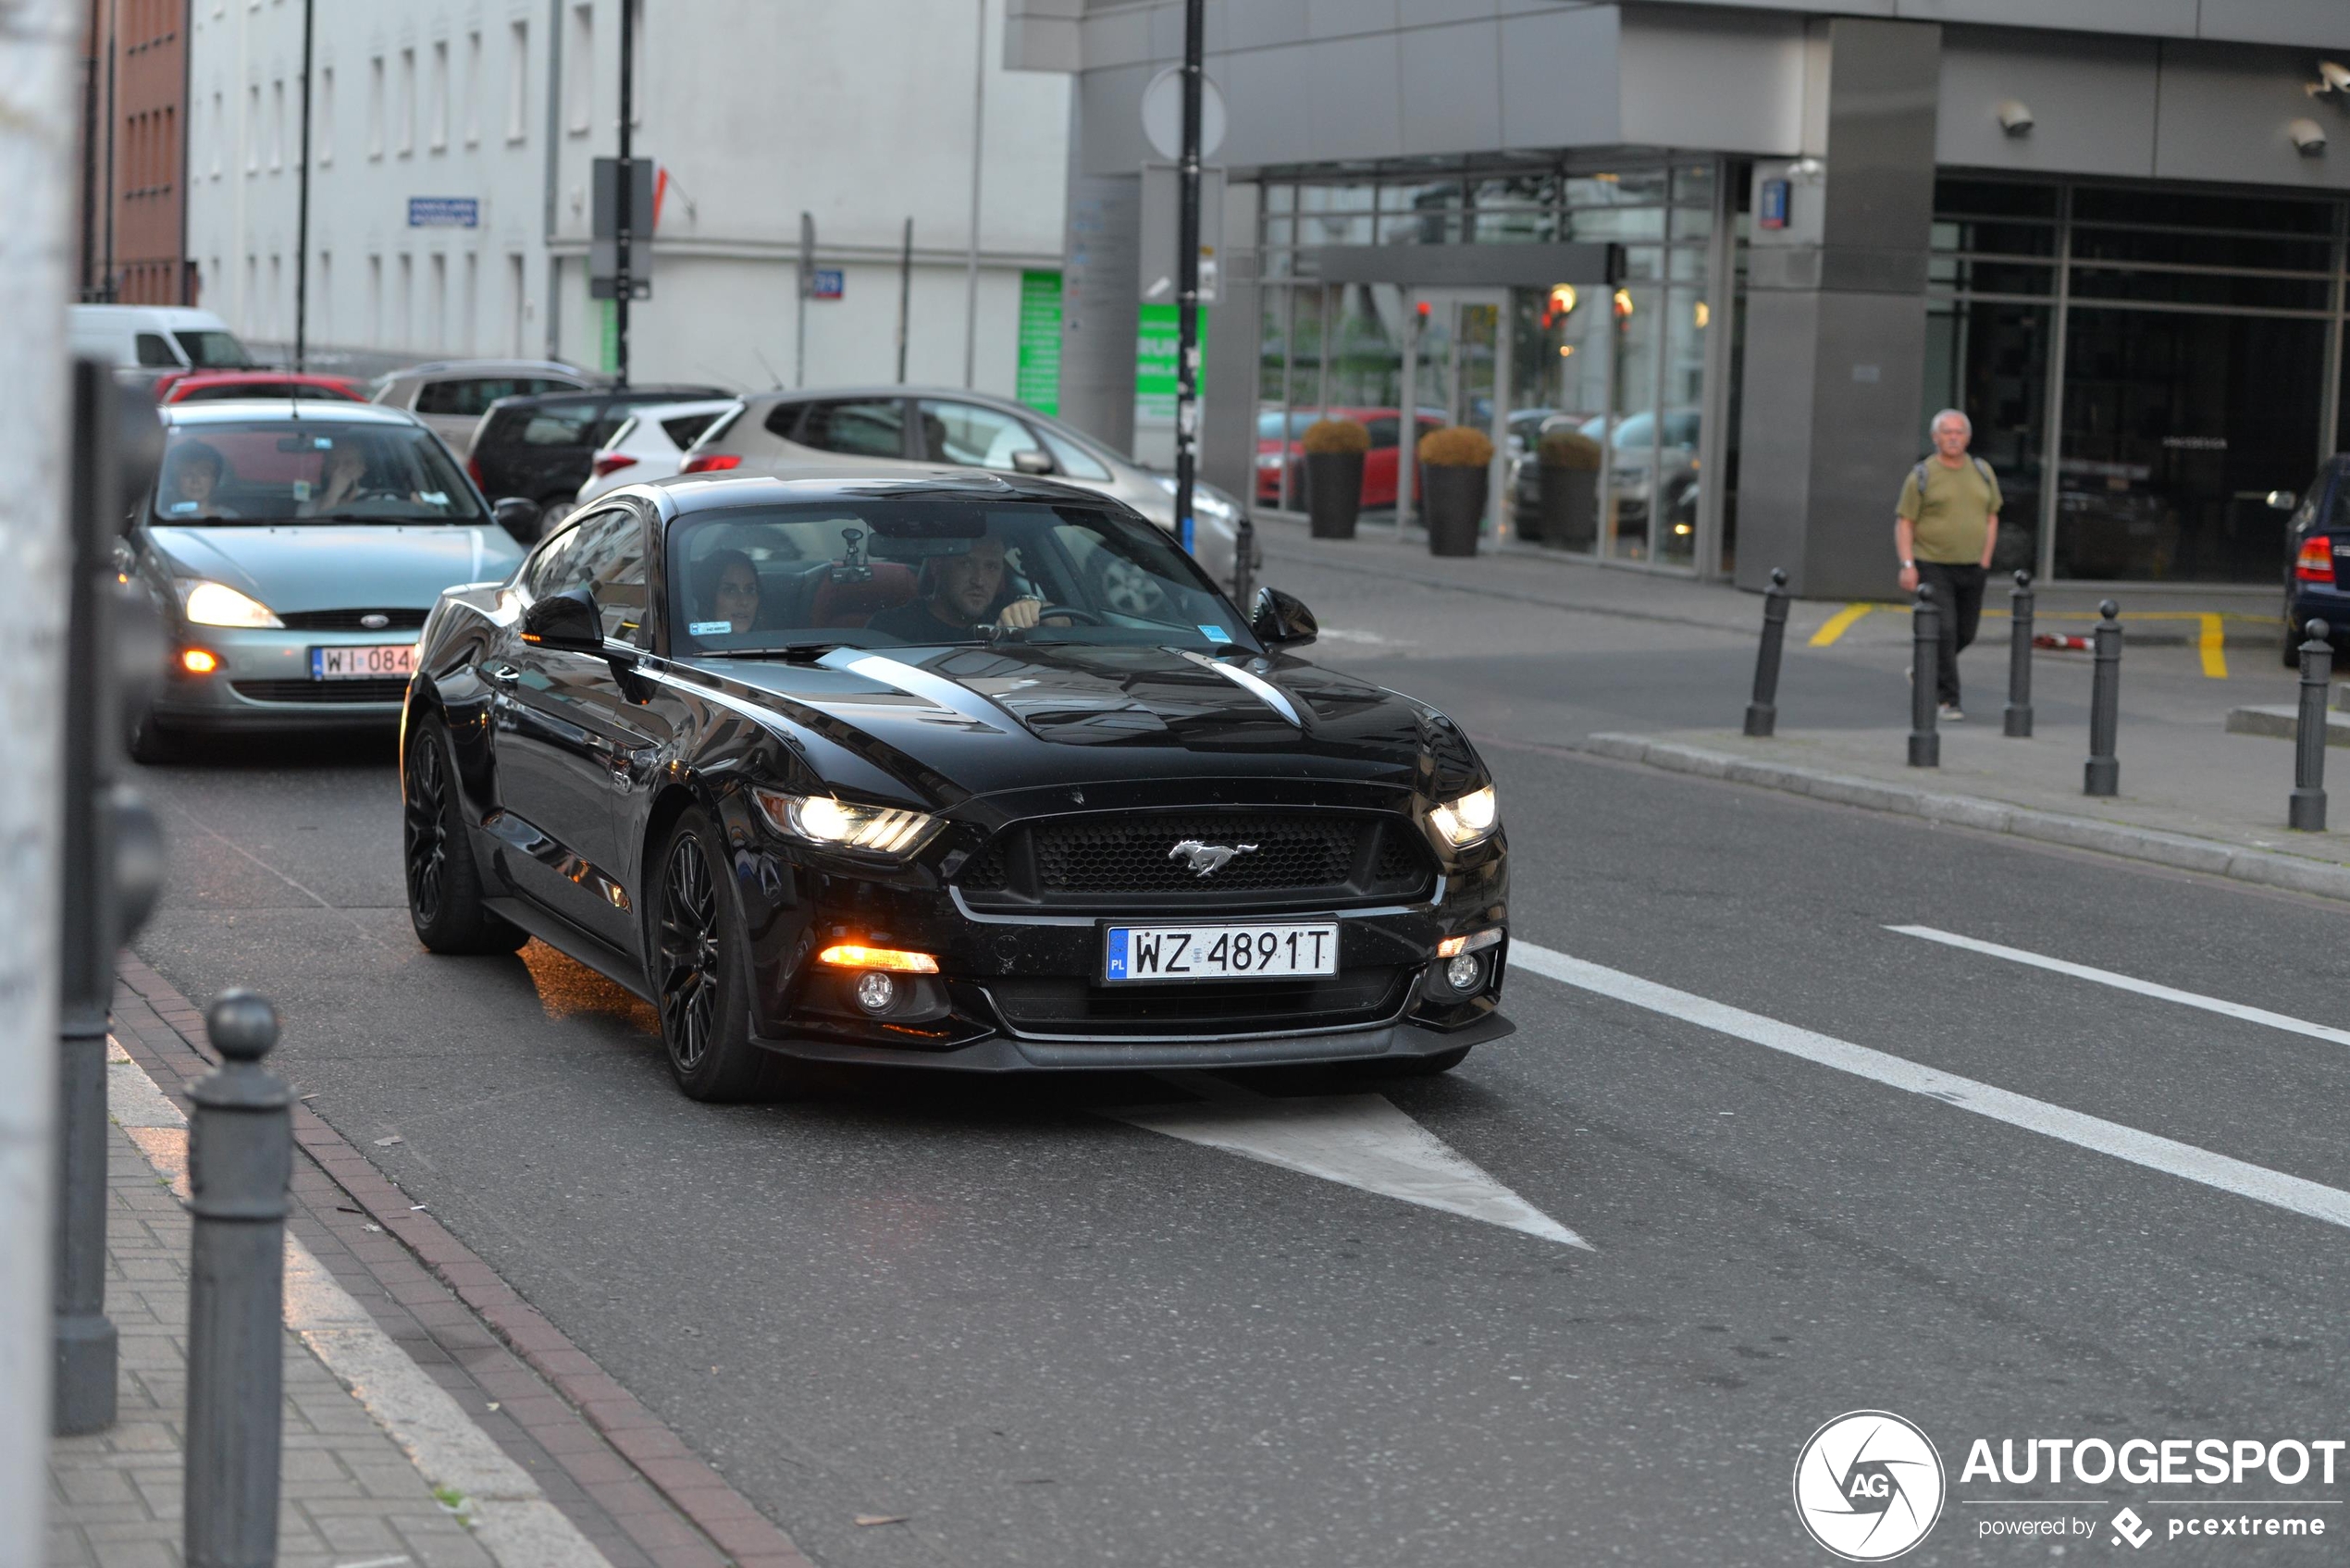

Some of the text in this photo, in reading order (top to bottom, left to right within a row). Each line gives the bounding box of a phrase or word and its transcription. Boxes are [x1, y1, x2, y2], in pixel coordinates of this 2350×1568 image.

[327, 650, 355, 673] WI
[1135, 931, 1330, 973] WZ 4891T
[1111, 960, 1125, 971] PL
